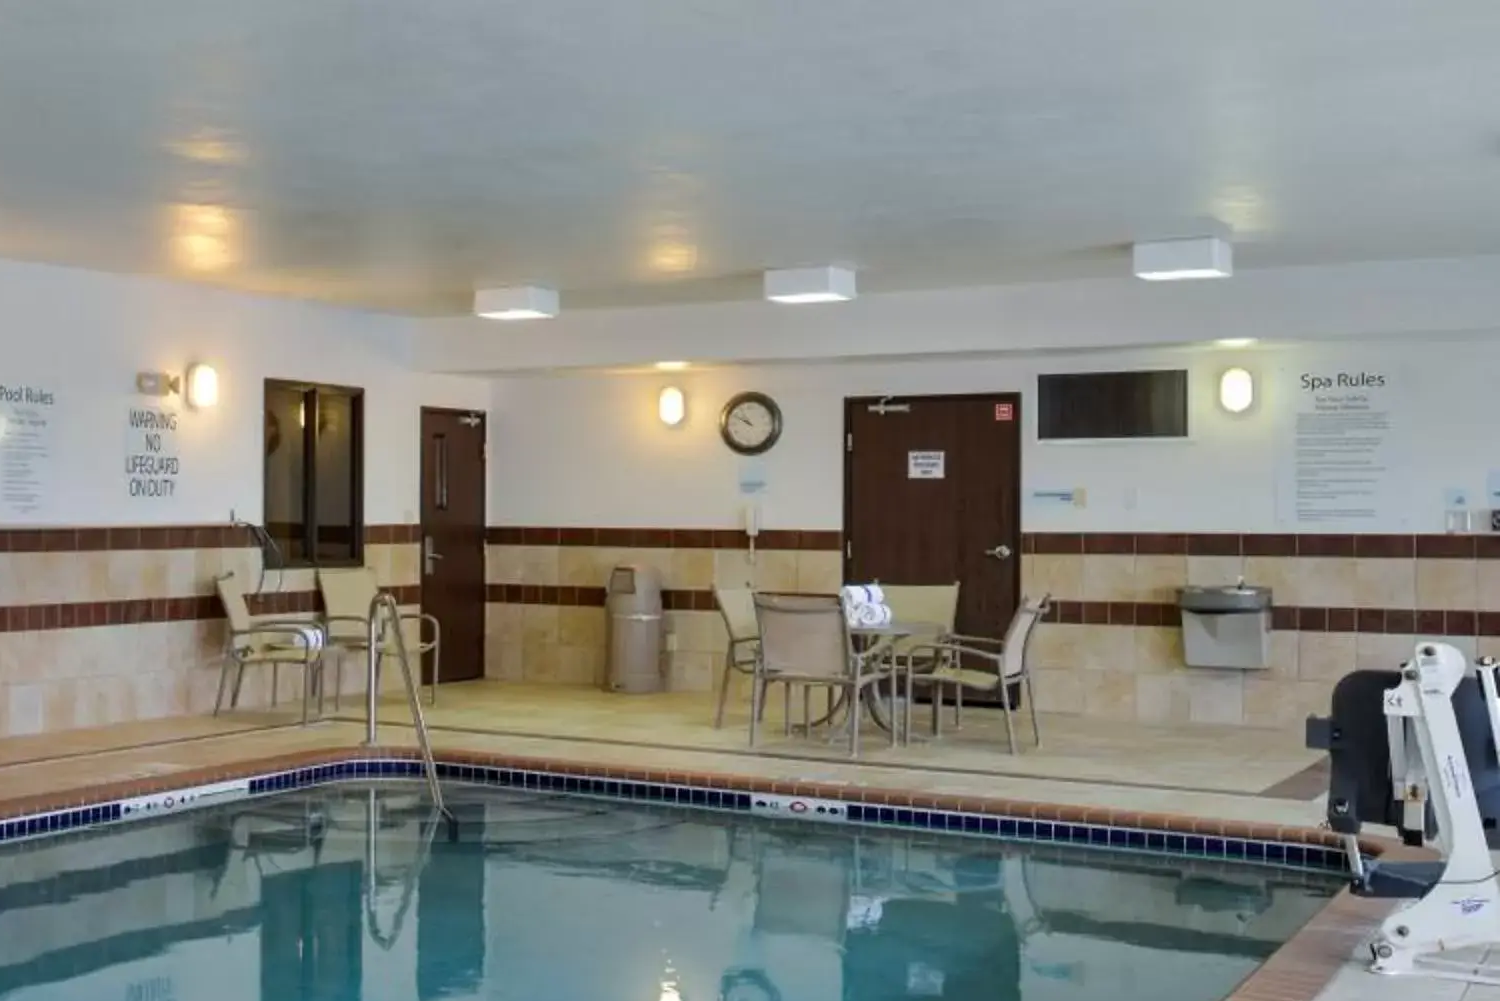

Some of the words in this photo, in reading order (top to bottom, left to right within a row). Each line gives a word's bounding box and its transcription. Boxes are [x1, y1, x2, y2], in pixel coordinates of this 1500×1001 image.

[1301, 374, 1332, 391] Spa
[1338, 373, 1385, 387] Rules
[0, 385, 22, 401] Pool
[25, 388, 54, 405] Rules
[130, 408, 177, 430] WARNING
[146, 433, 161, 452] NO
[126, 455, 179, 475] LIFEGUARD
[129, 478, 146, 497] ON
[148, 479, 174, 497] DUTY
